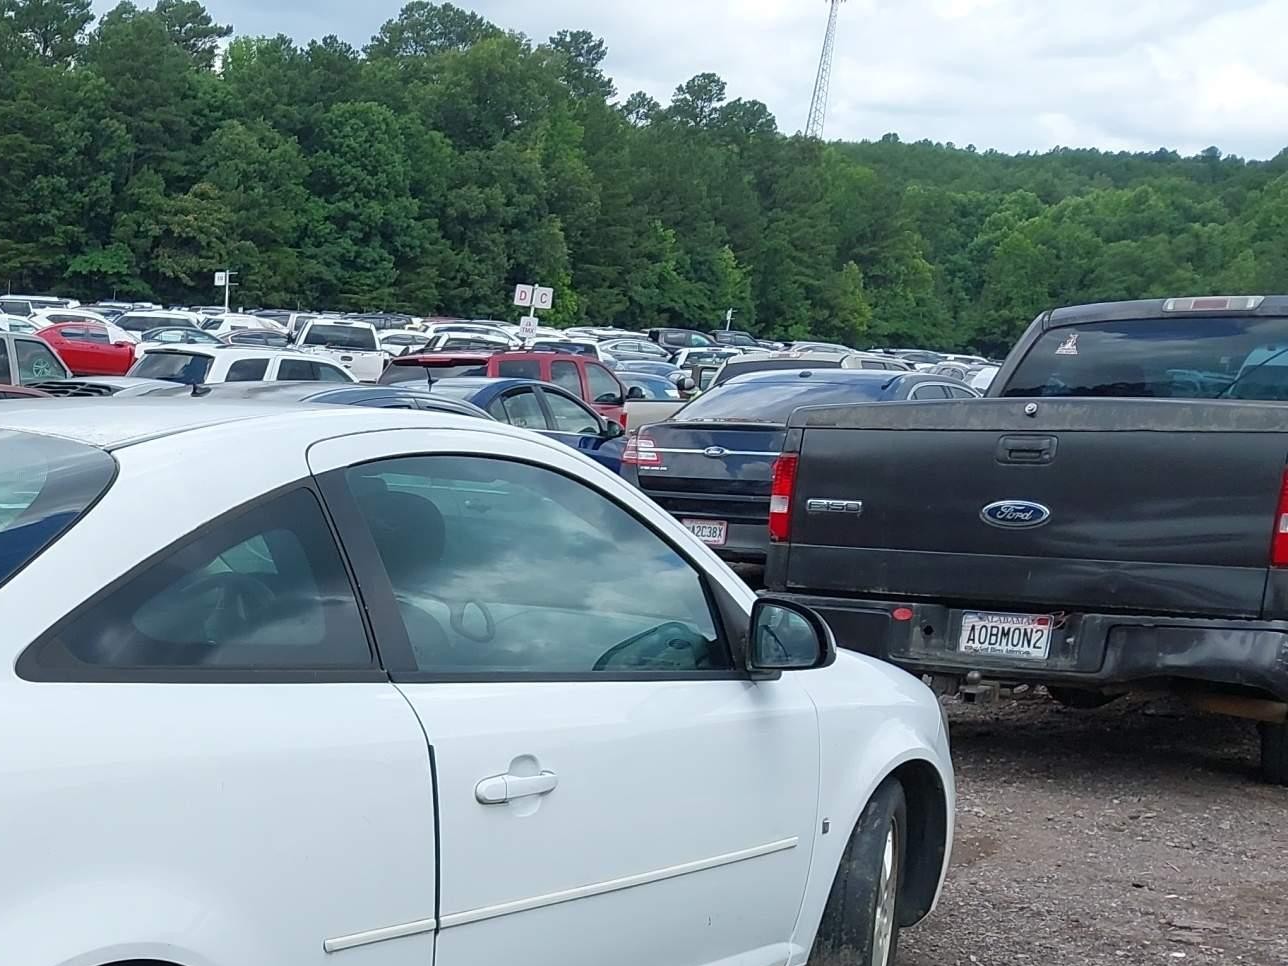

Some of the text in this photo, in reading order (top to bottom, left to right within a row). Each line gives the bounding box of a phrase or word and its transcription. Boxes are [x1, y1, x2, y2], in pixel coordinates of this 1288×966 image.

[519, 290, 527, 301] D
[540, 292, 548, 304] C
[996, 505, 1034, 520] Ford
